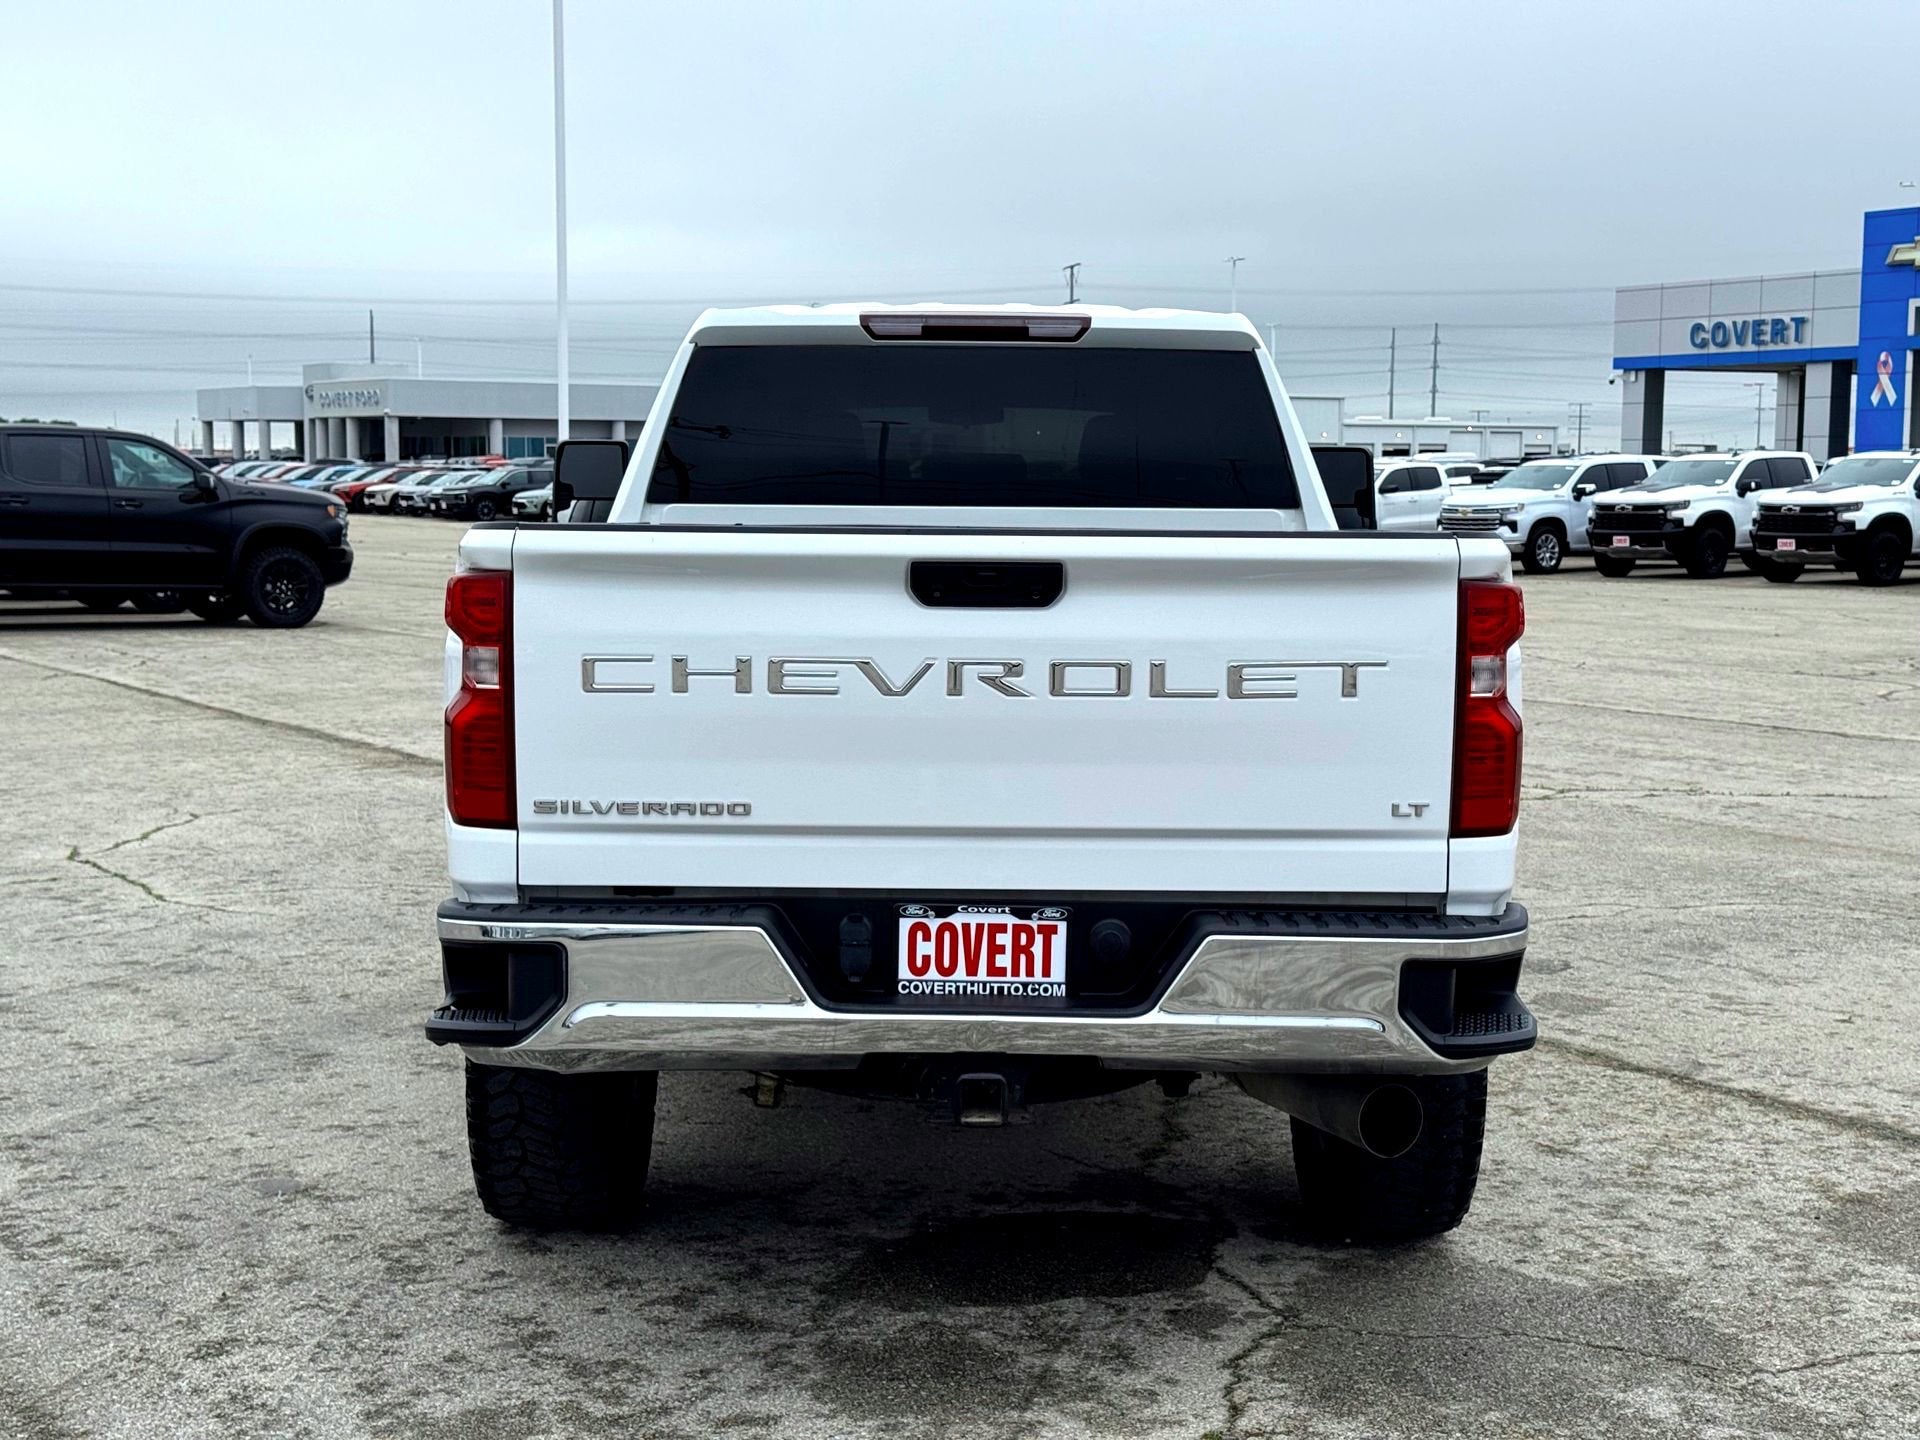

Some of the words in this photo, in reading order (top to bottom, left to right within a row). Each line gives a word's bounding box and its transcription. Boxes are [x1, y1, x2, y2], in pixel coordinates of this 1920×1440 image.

[1689, 316, 1808, 349] COVERT
[581, 655, 1390, 702] CHEVROLET
[533, 799, 752, 817] SILVERADO
[1391, 801, 1430, 818] LT
[957, 905, 1011, 914] Covert
[907, 921, 1058, 978] COVERT
[897, 981, 1066, 997] COVERTHUTTO.COM
